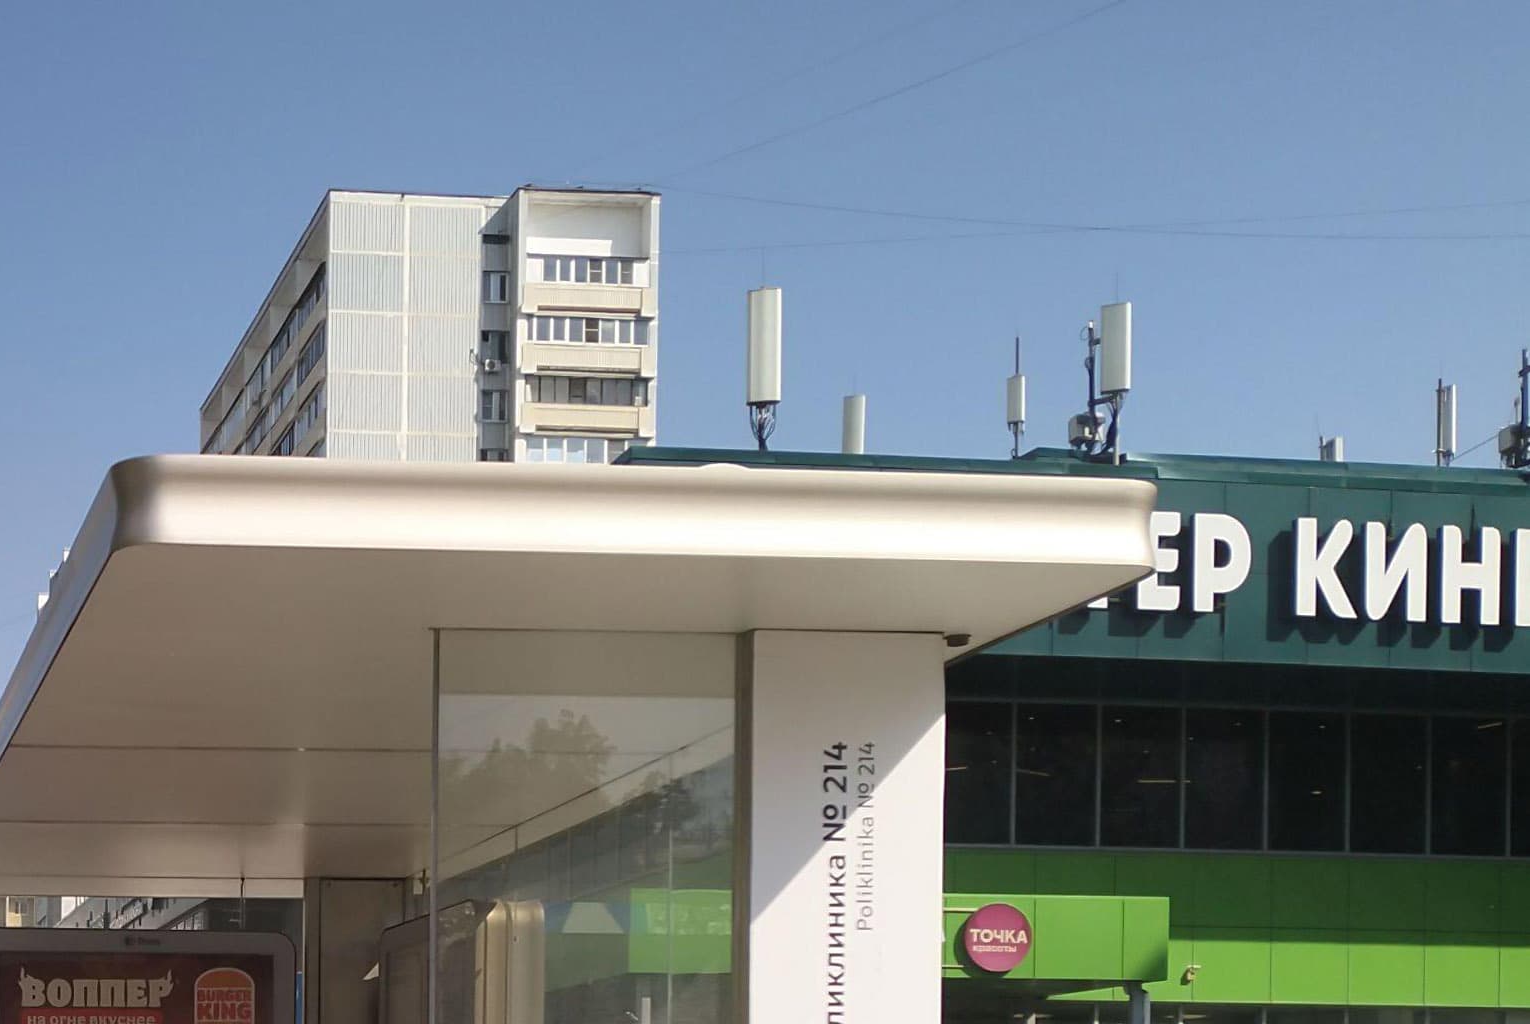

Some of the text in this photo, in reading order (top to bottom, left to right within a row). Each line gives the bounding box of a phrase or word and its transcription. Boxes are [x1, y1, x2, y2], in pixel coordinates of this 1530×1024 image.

[1087, 511, 1253, 613] ЕР
[823, 741, 848, 793] 214
[858, 742, 875, 780] 214
[856, 816, 875, 931] Poliklinika
[969, 928, 1028, 944] ТОЧКА
[20, 974, 172, 1009] ВОППЕР
[197, 988, 253, 1002] BURGER
[196, 1002, 253, 1022] KING
